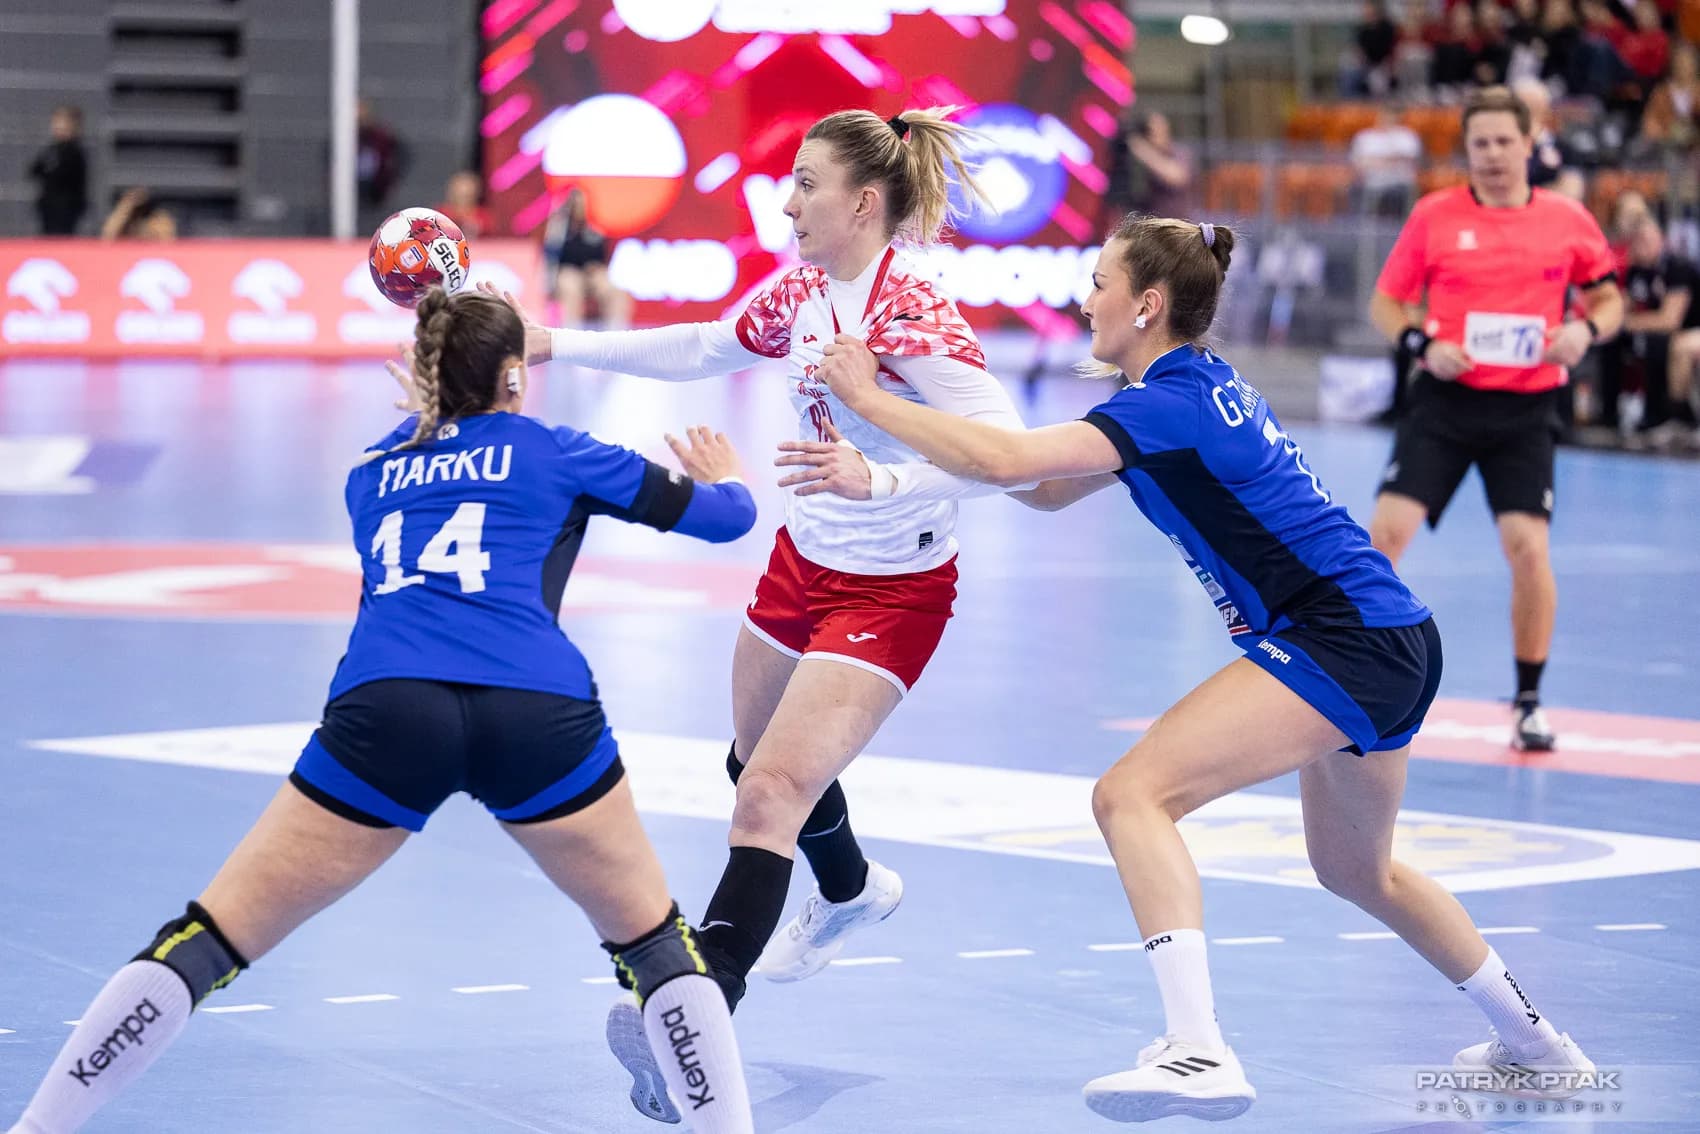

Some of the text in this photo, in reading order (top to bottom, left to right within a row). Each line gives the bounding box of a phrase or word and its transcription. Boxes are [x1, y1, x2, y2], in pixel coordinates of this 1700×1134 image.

[378, 444, 513, 498] MARKU
[371, 502, 491, 596] 14
[68, 998, 162, 1088] Kempa
[660, 1004, 715, 1111] Kempa
